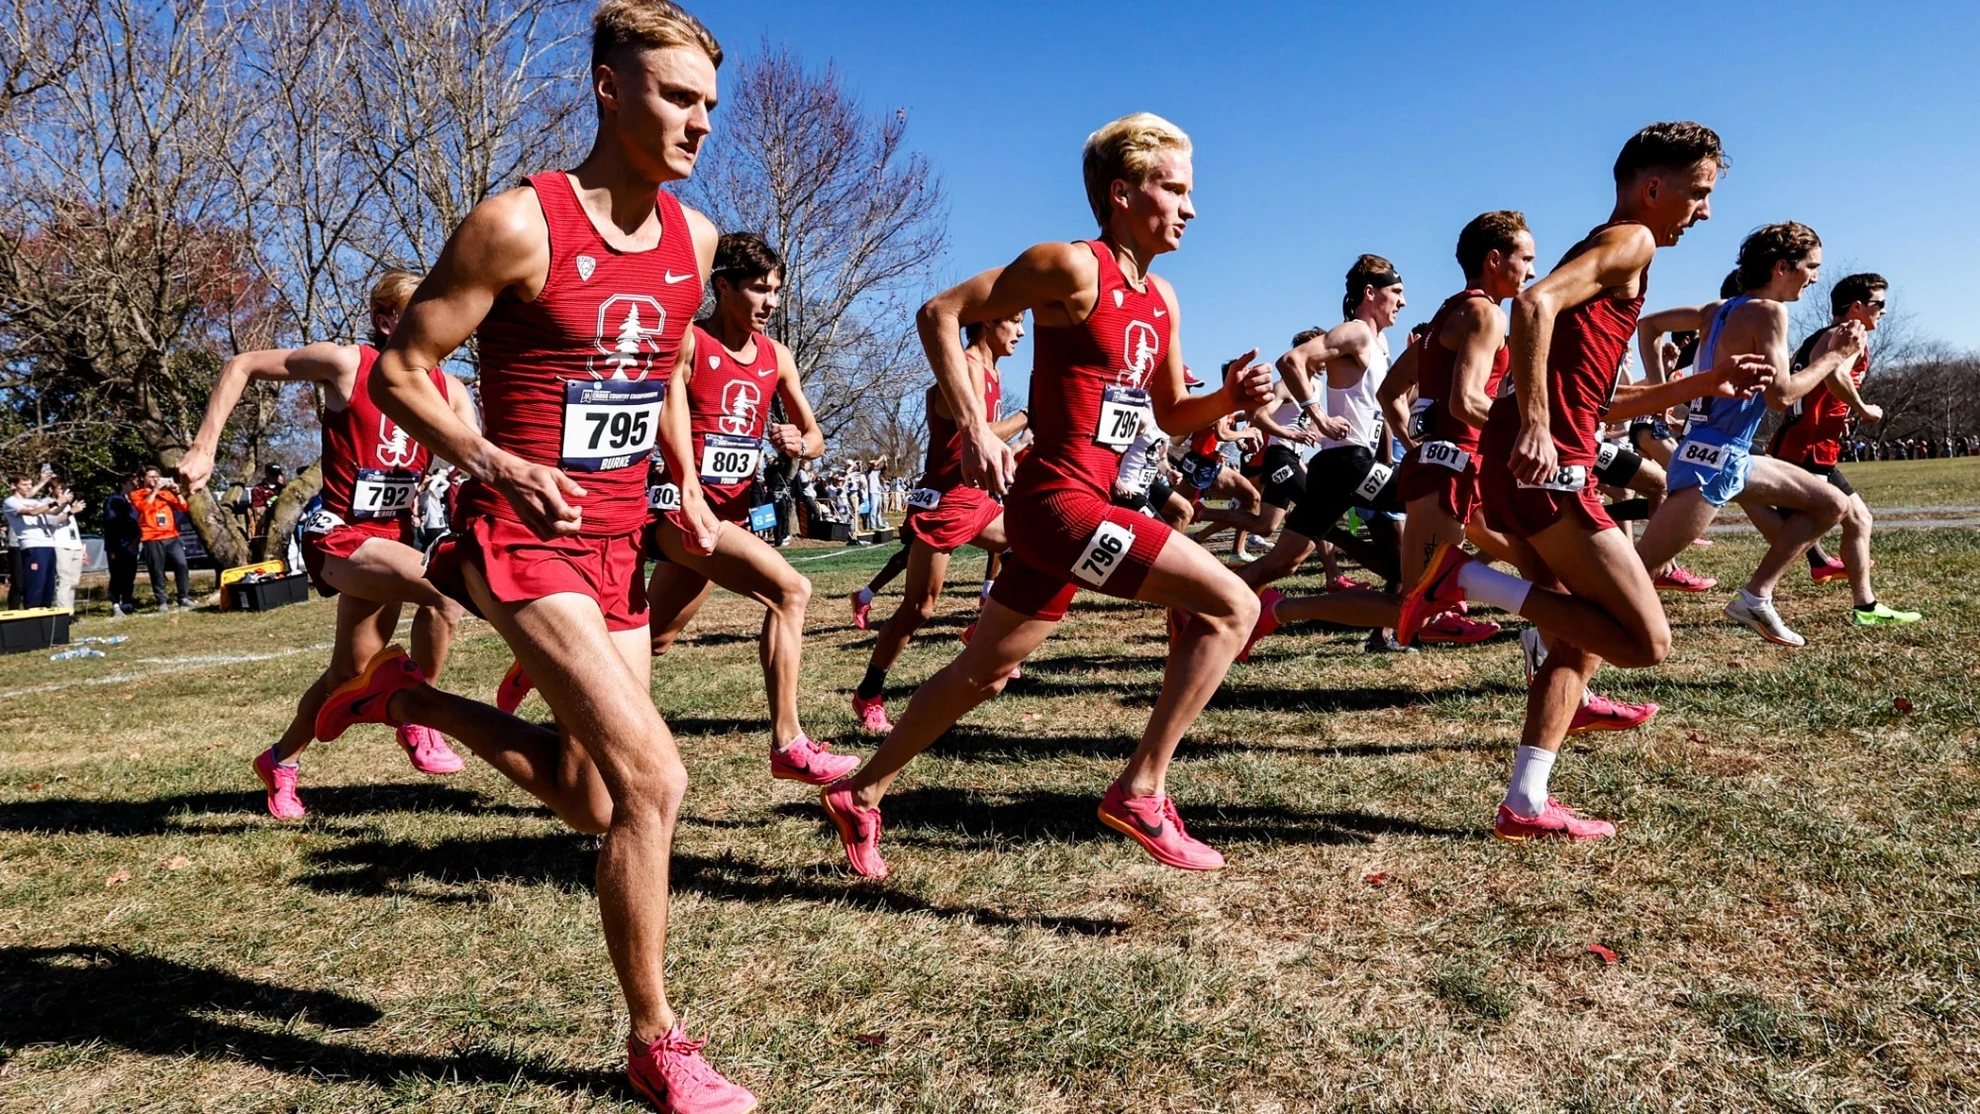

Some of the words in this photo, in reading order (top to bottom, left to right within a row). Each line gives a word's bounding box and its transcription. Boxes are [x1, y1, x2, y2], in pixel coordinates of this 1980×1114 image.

[586, 410, 650, 450] 795
[1111, 409, 1138, 439] 796
[600, 455, 631, 471] BURKE
[712, 452, 749, 473] 803
[1426, 444, 1460, 464] 801
[1686, 445, 1719, 465] 844
[1364, 469, 1387, 494] 672
[368, 486, 409, 506] 792
[1081, 533, 1122, 577] 796
